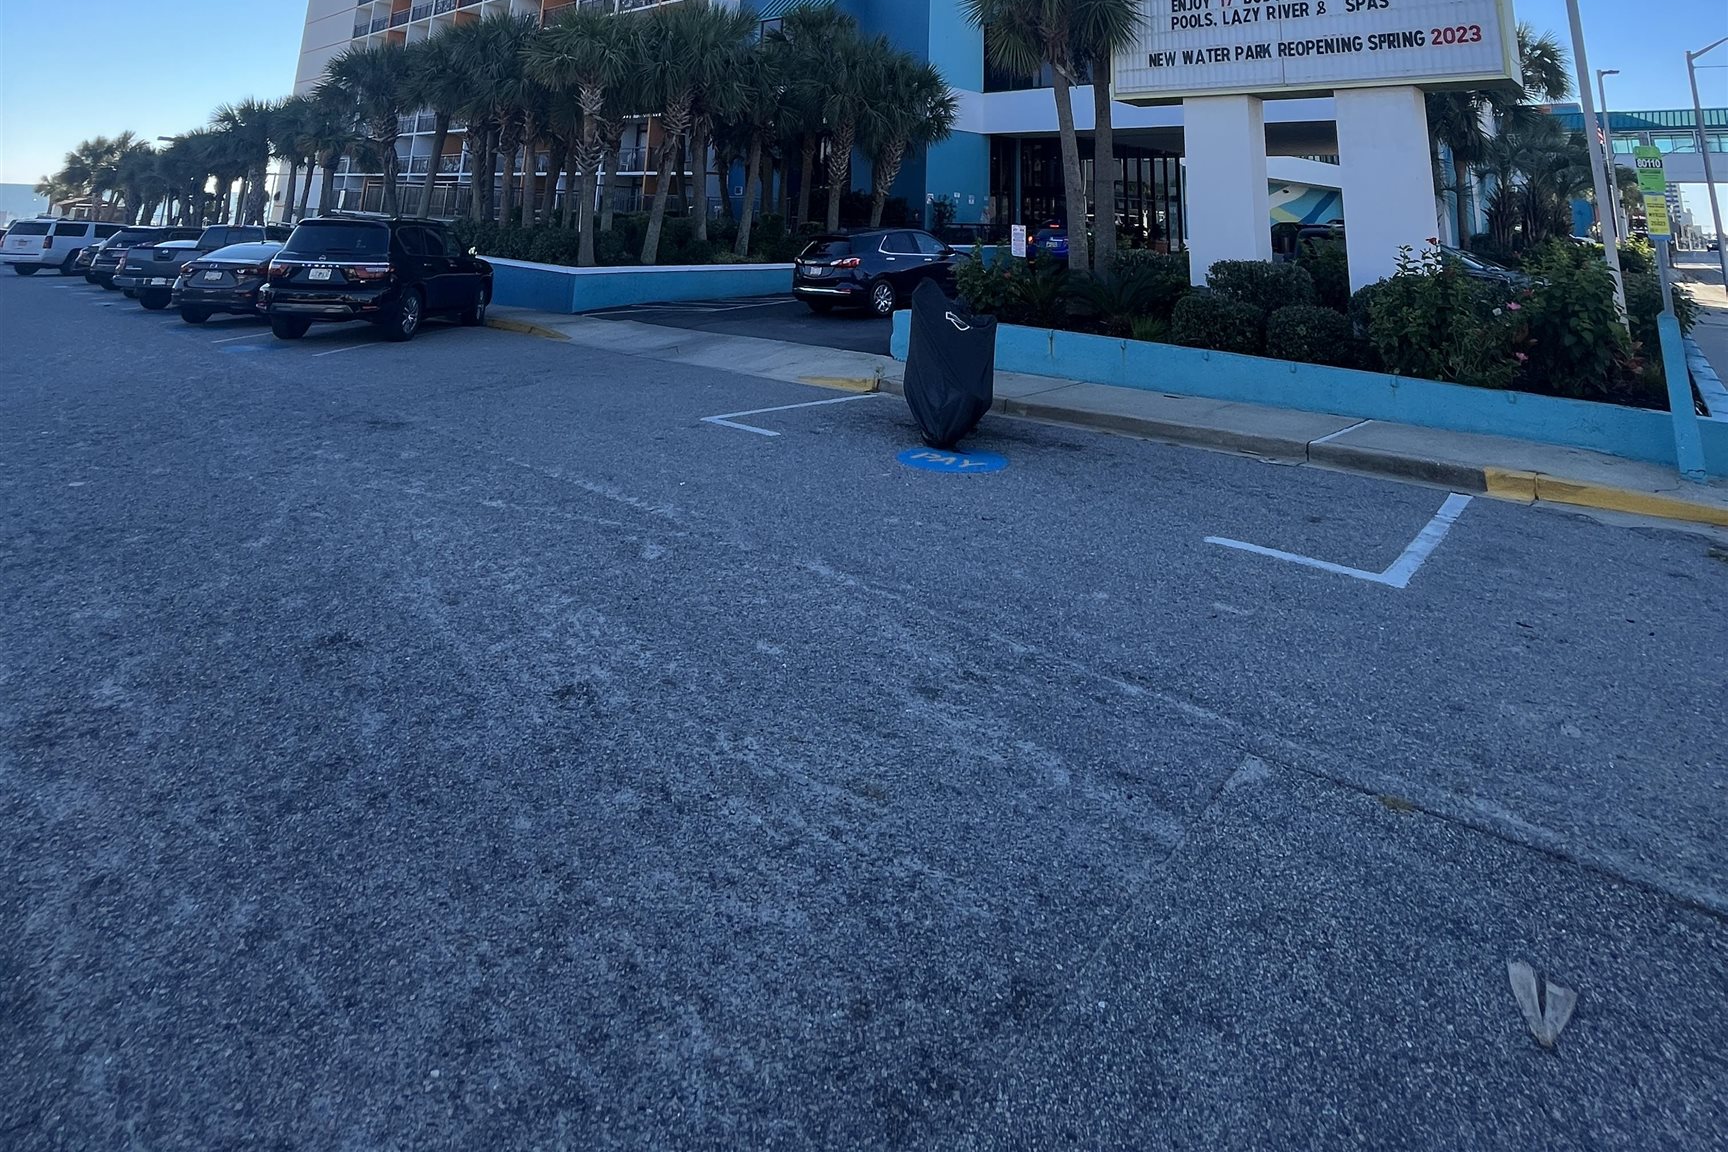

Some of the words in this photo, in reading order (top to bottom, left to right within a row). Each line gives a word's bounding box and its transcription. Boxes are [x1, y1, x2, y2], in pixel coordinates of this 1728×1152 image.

[1222, 7, 1260, 26] LAZY
[1267, 0, 1309, 20] RIVER
[1316, 0, 1327, 16] &
[1148, 52, 1176, 67] NEW
[1182, 46, 1230, 65] WATER
[1235, 43, 1271, 61] PARK
[1278, 36, 1363, 58] REOPENING
[1368, 30, 1425, 50] SPRING
[1431, 25, 1482, 45] 2023
[1637, 159, 1661, 168] 80110
